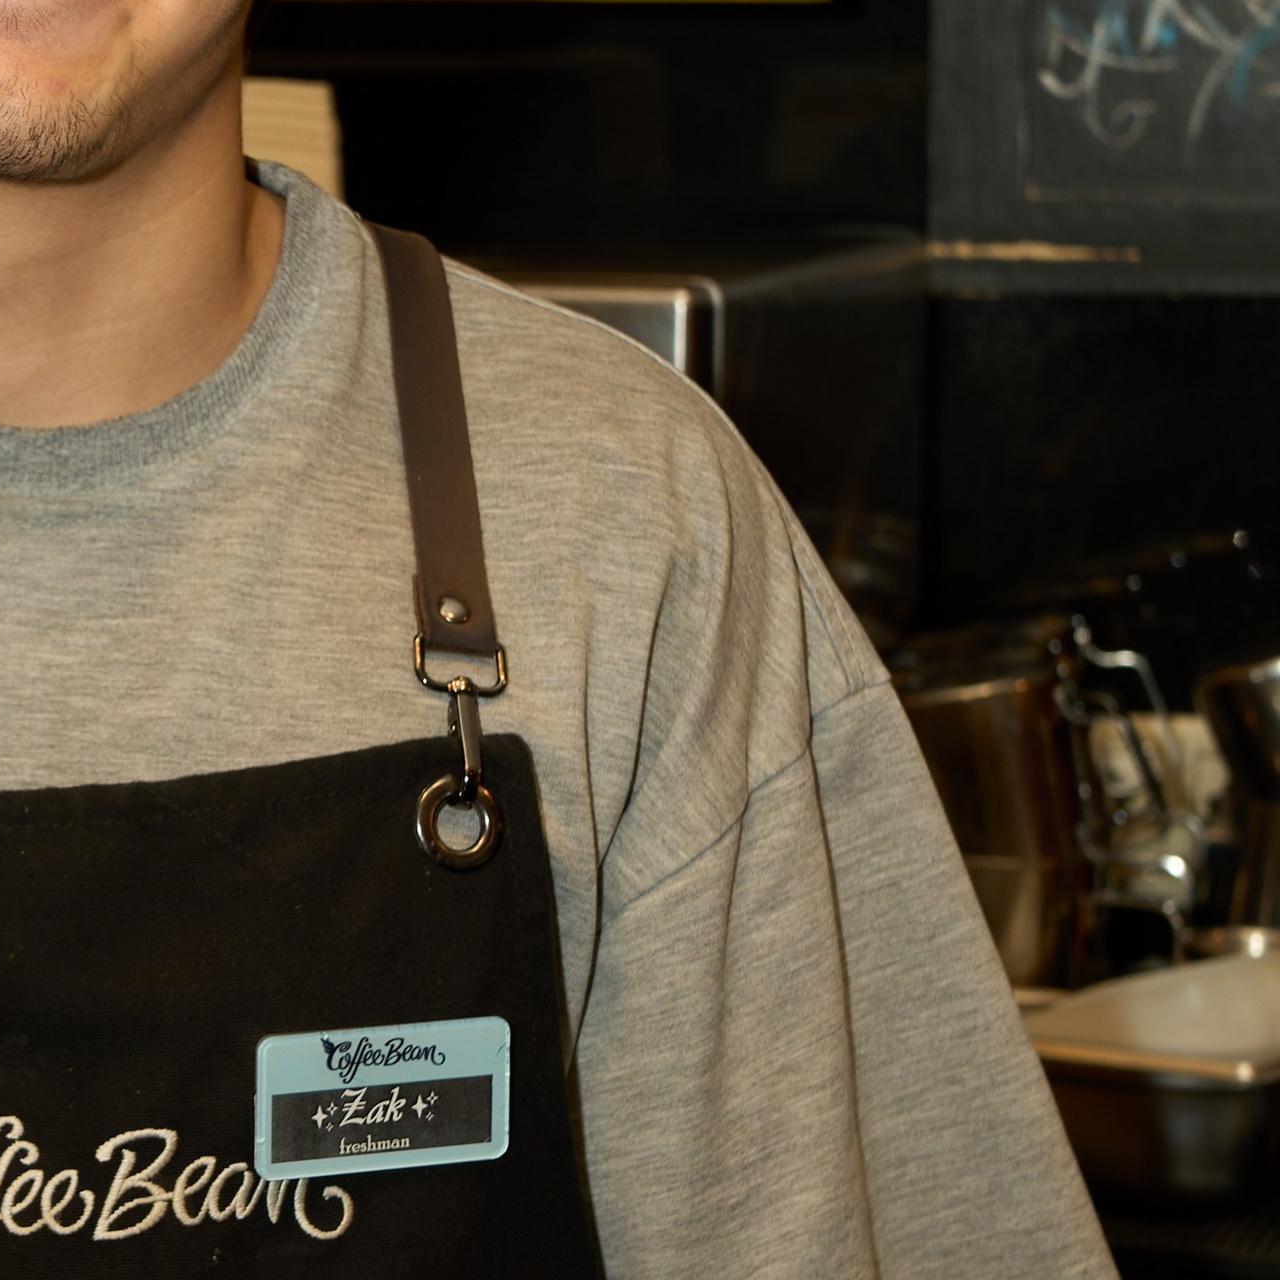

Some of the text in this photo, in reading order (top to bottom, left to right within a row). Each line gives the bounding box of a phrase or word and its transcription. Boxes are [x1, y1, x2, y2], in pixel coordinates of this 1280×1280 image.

[325, 1036, 446, 1084] Coffee Bean
[338, 1085, 408, 1128] Zak
[338, 1134, 411, 1155] freshman
